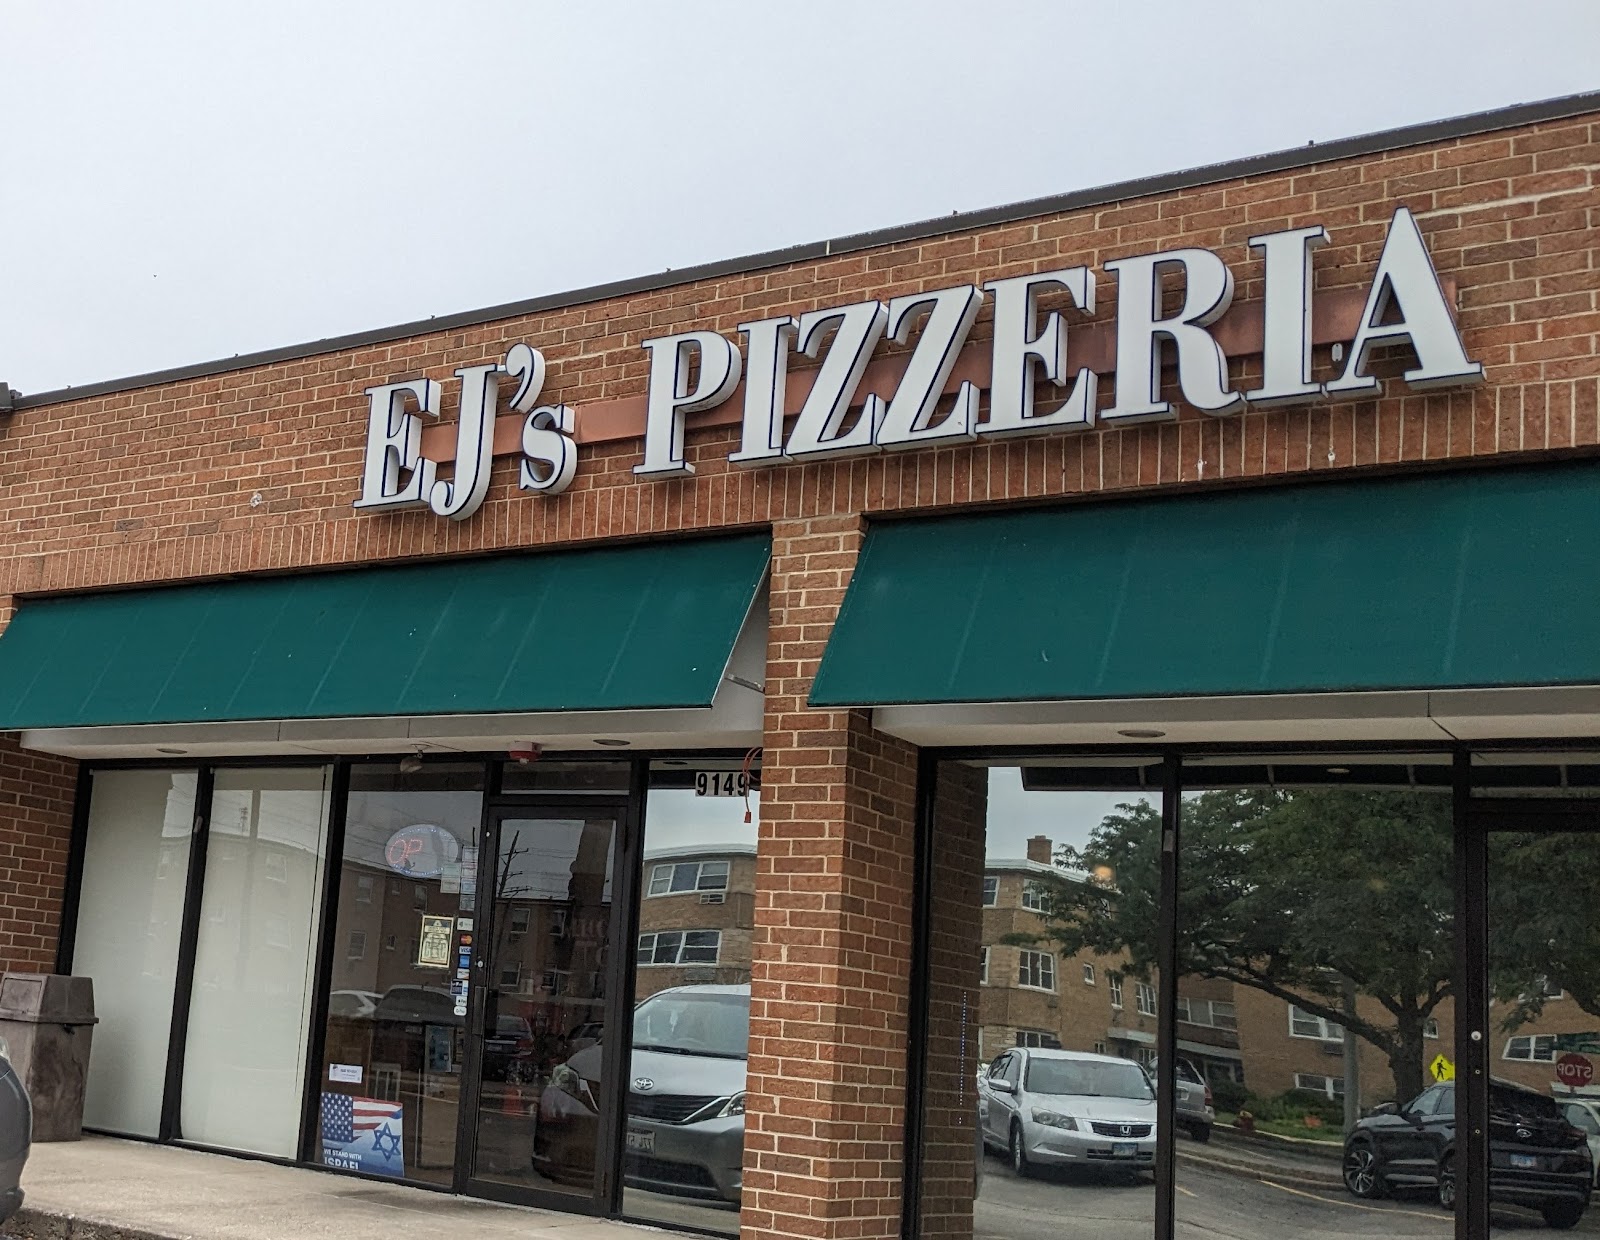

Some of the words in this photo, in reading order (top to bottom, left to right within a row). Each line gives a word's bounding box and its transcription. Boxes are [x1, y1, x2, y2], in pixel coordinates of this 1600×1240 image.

[353, 342, 578, 521] EJ's
[632, 206, 1487, 478] PIZZERIA
[697, 772, 748, 797] 9149
[460, 946, 472, 954] VISA
[332, 1150, 349, 1158] STAND
